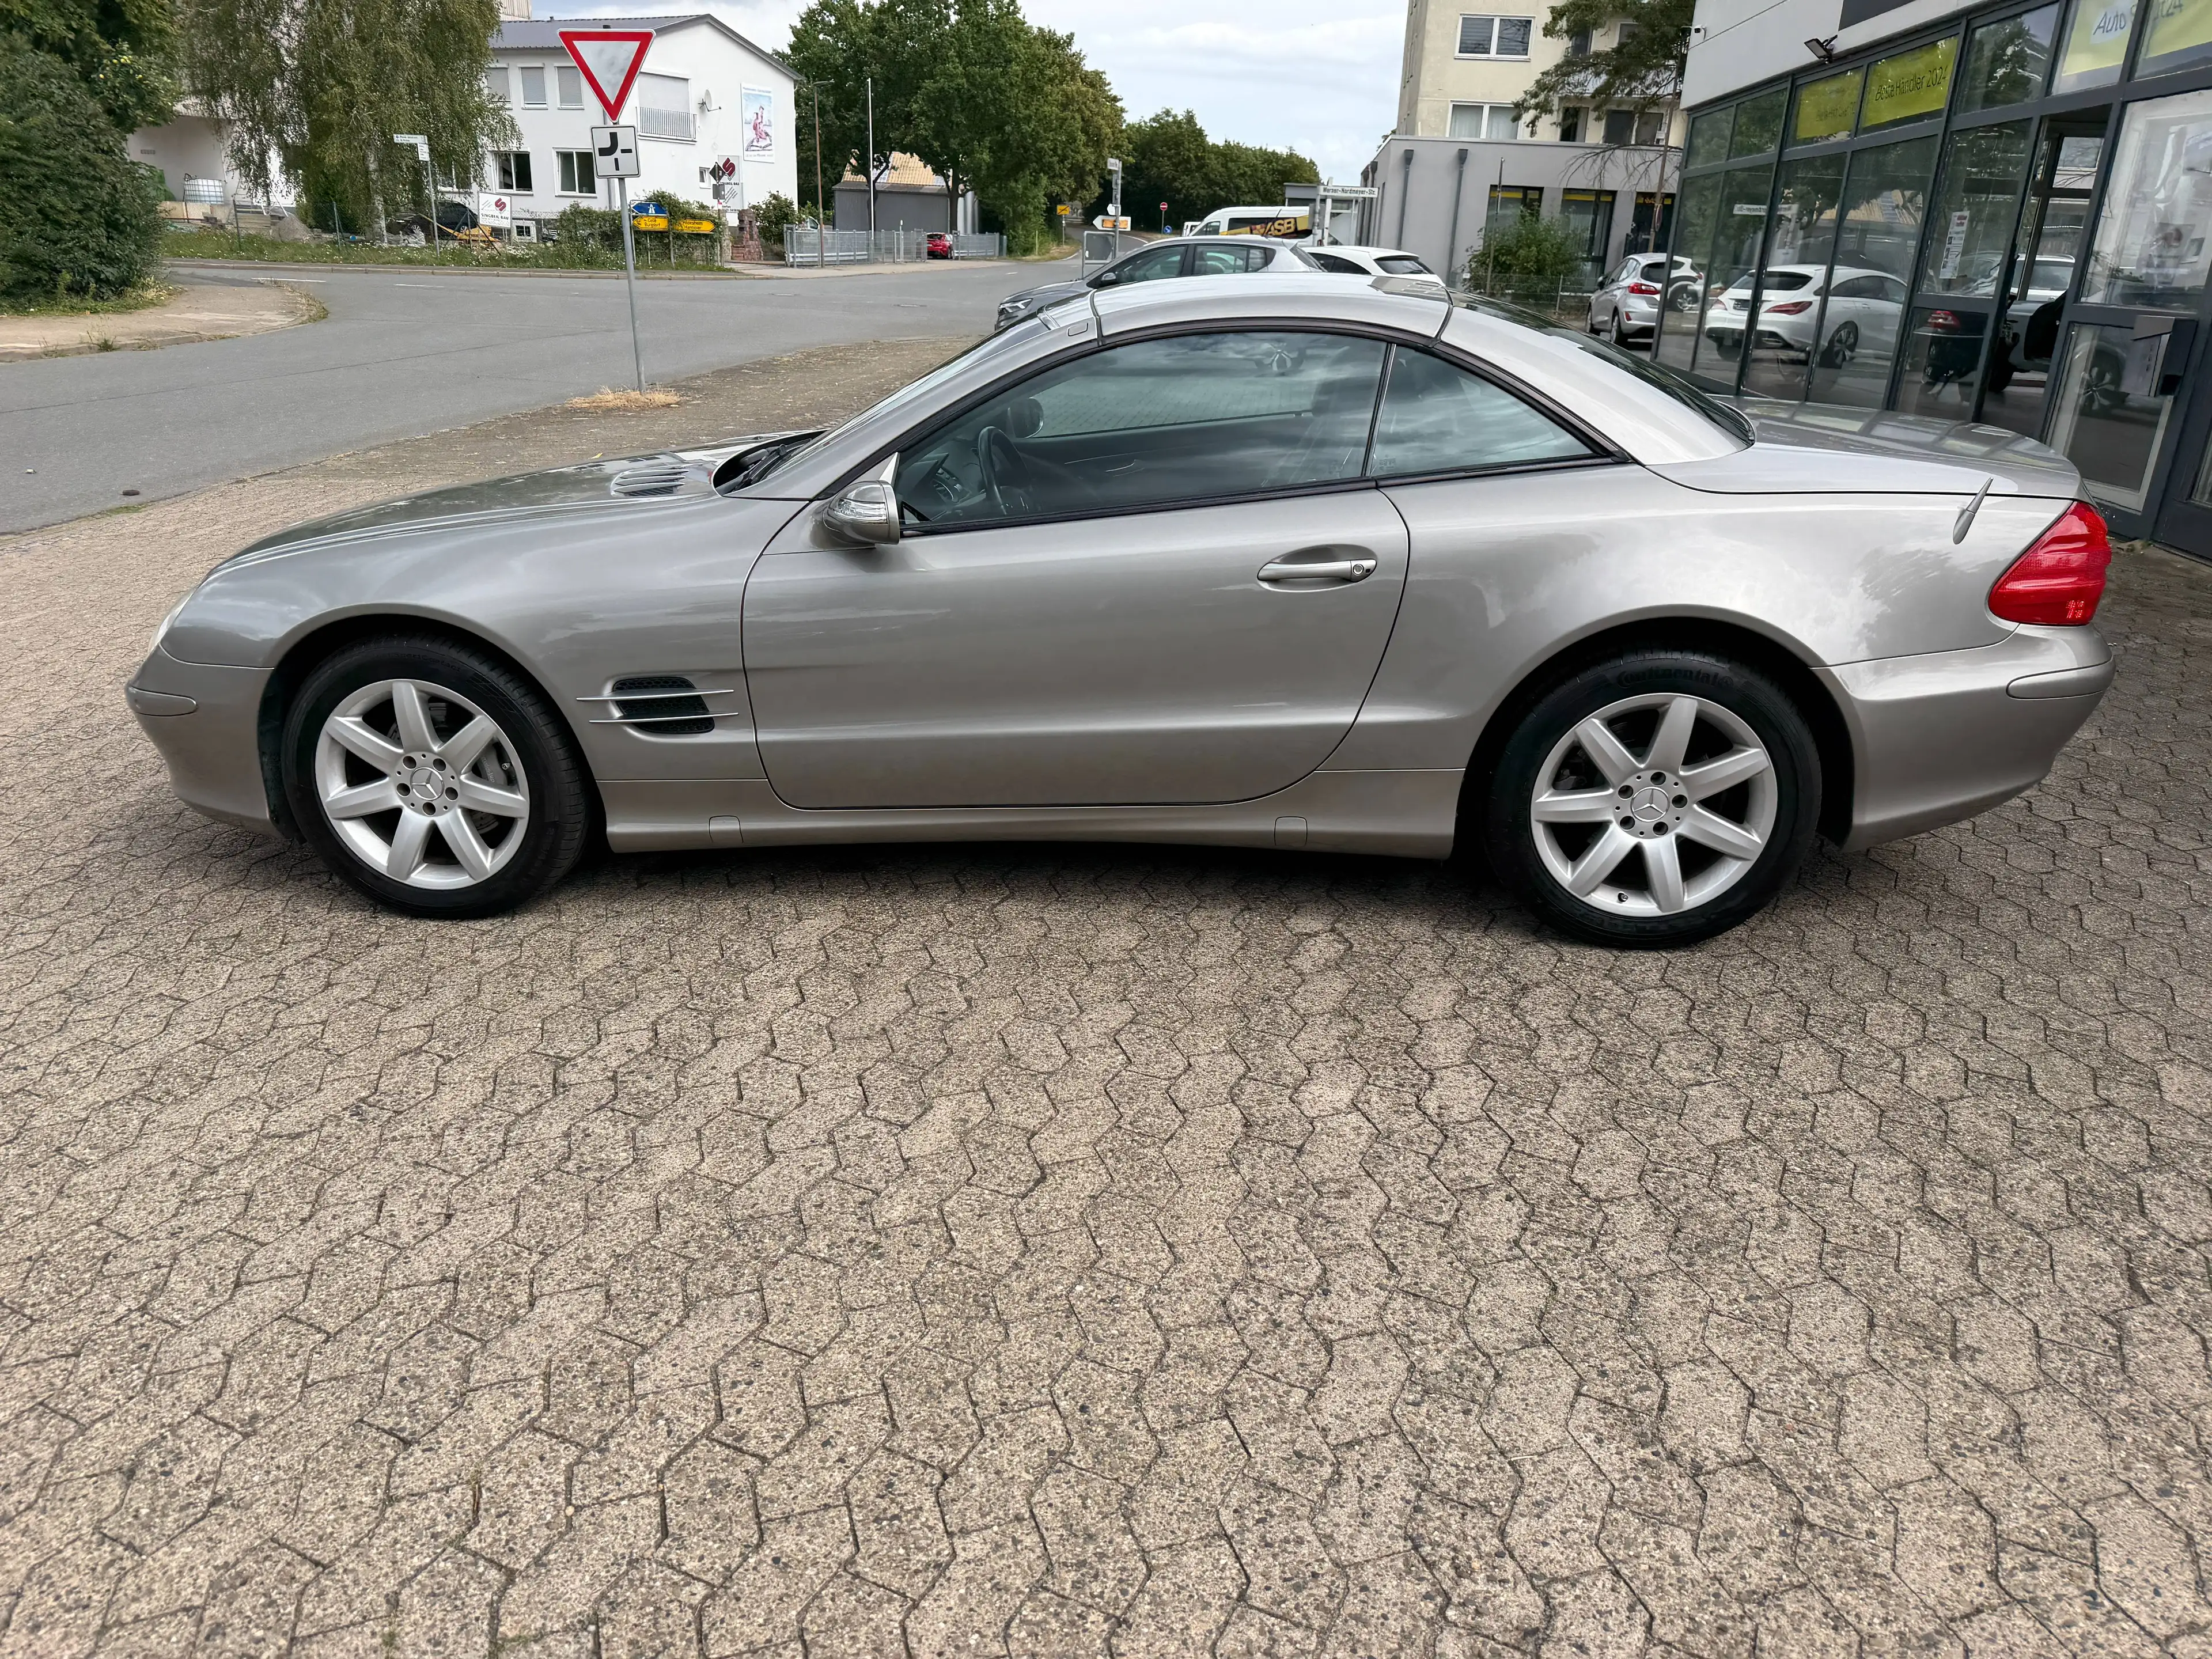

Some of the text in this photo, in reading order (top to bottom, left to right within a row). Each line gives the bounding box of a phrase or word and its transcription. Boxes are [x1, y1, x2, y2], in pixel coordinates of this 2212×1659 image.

[2093, 12, 2126, 35] Auto
[1896, 73, 1925, 96] Händler
[1927, 65, 1948, 87] 2024
